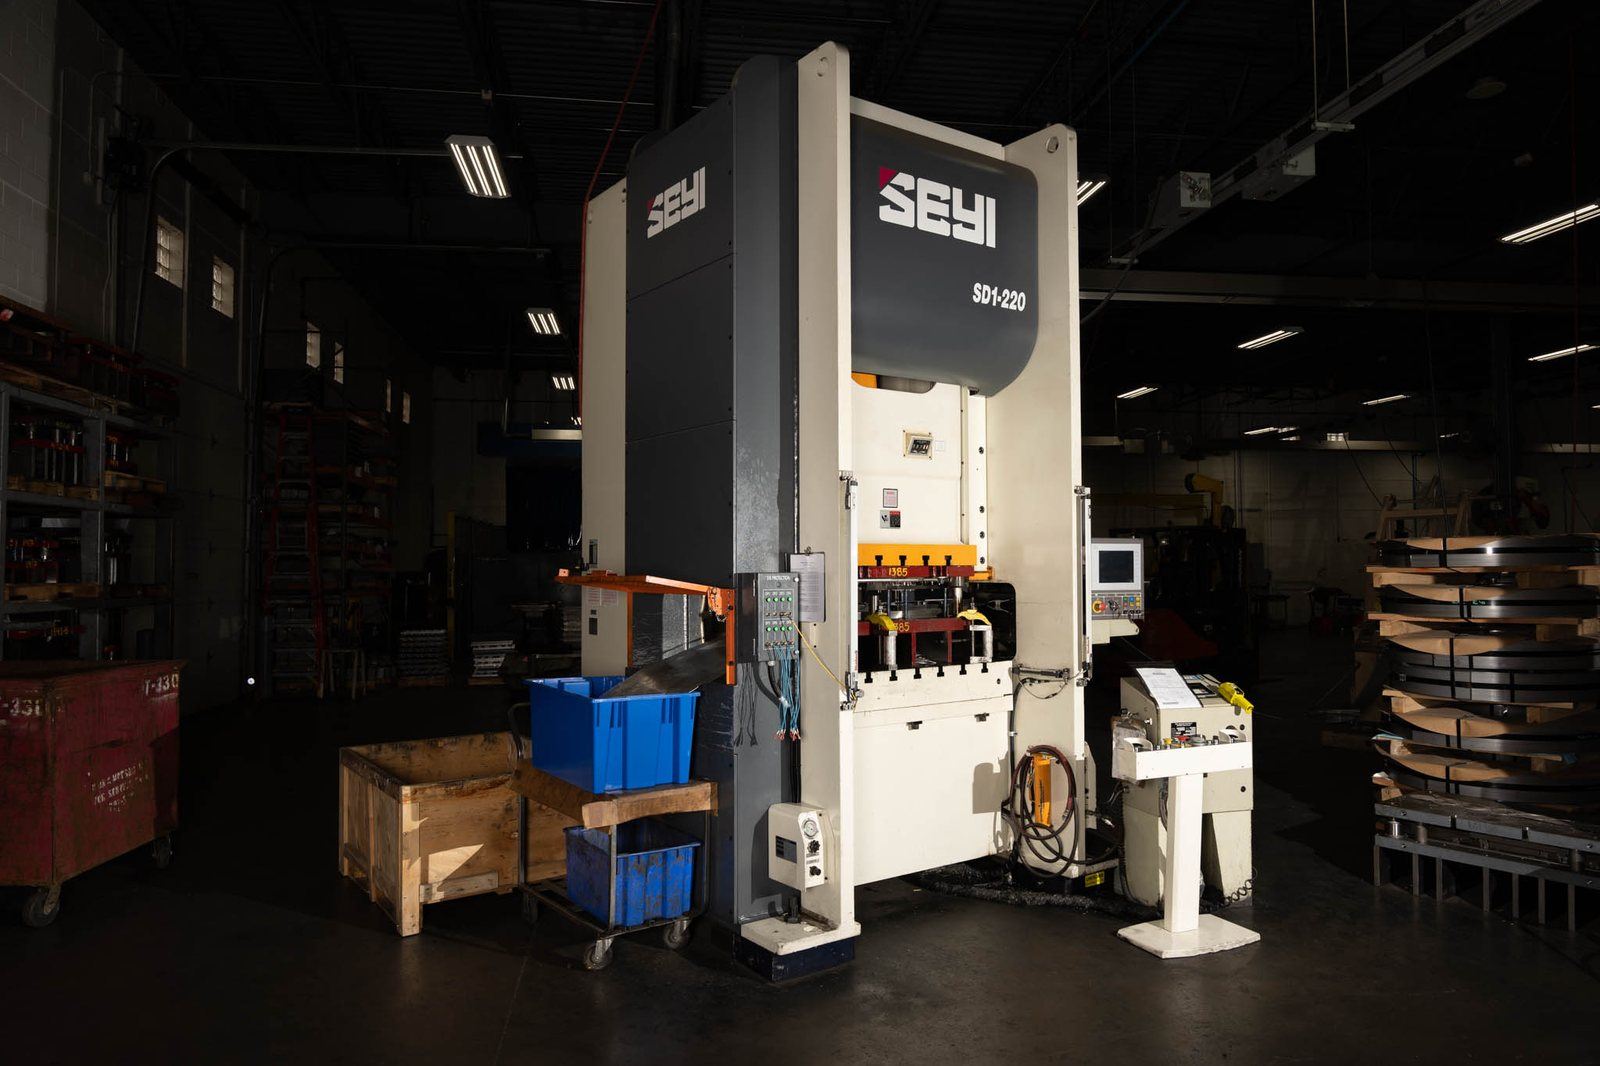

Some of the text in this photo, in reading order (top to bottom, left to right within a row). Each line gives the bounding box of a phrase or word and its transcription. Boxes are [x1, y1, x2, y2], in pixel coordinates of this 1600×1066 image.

[646, 166, 706, 240] SEYI
[879, 169, 996, 249] SEYI
[972, 282, 1026, 312] SD1-220
[888, 567, 908, 578] 1385
